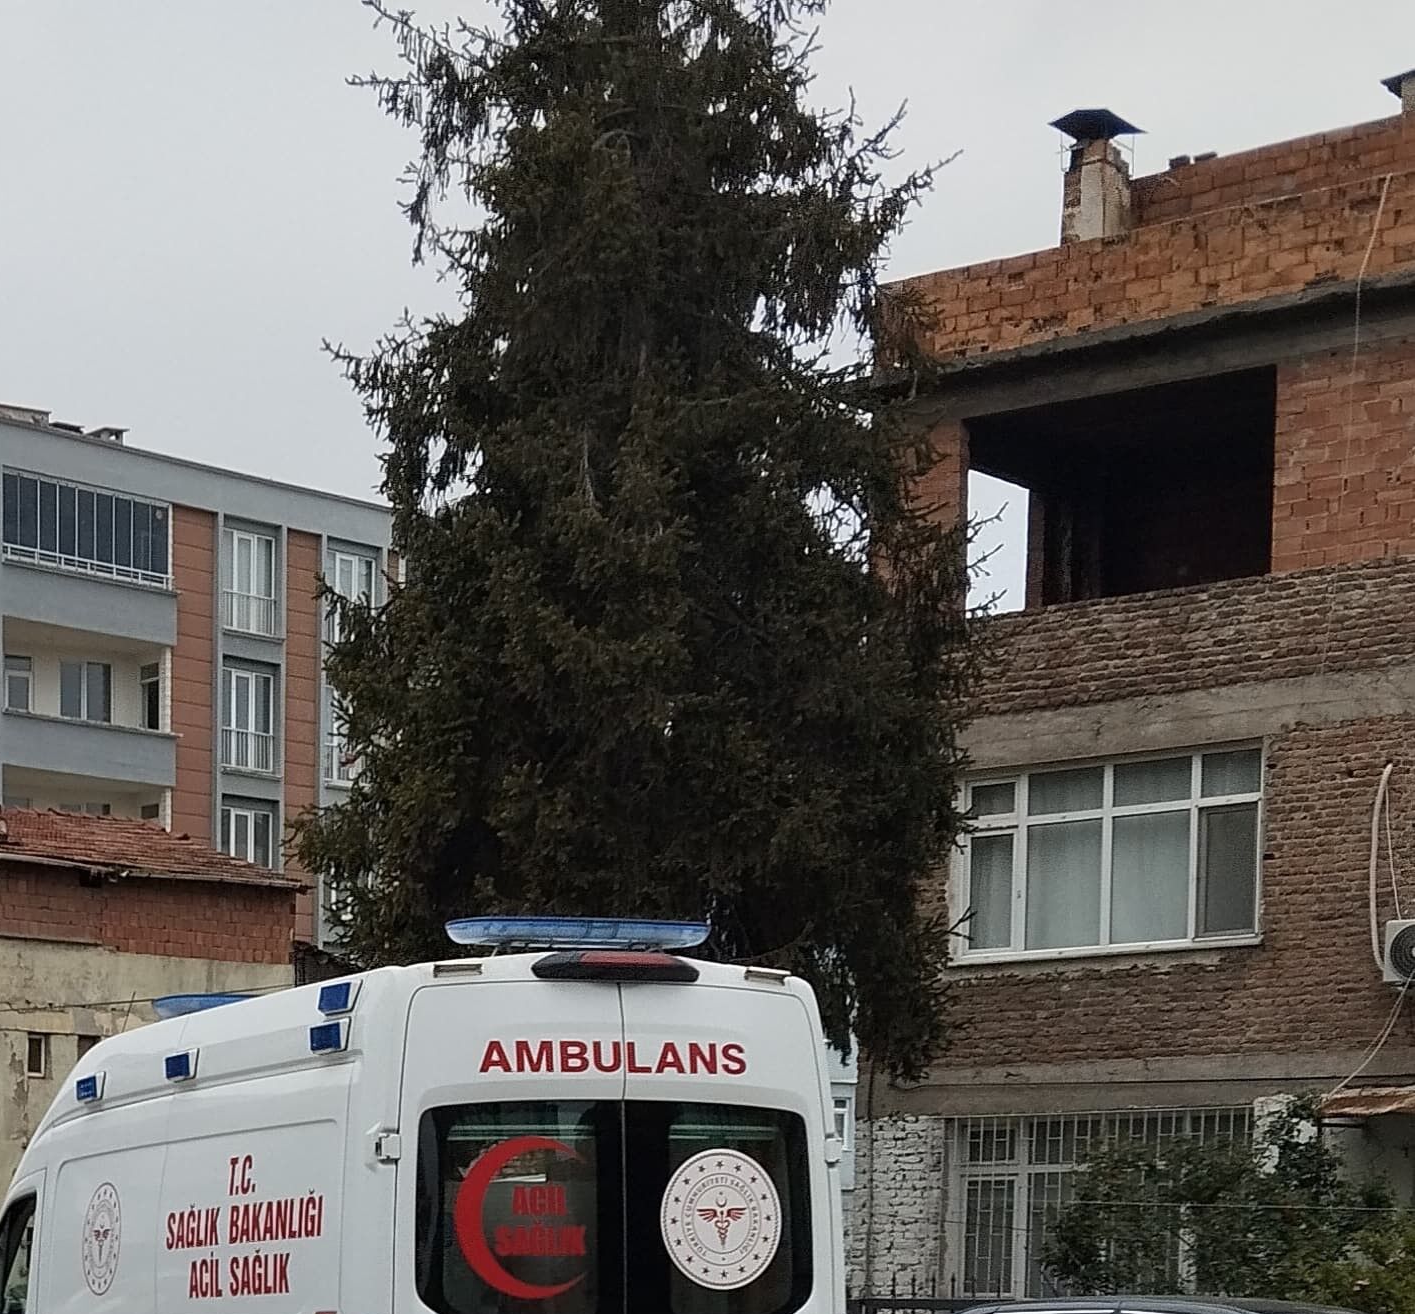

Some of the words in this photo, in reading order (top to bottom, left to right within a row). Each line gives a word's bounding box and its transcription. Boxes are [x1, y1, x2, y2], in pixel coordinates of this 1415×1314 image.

[479, 1040, 747, 1075] AMBULANS
[229, 1154, 257, 1197] T.C.
[166, 1202, 221, 1250] SAĞLIK
[228, 1188, 324, 1245] BAKANLIĞI
[189, 1251, 224, 1299] ACİL
[229, 1249, 291, 1297] SAĞLIK
